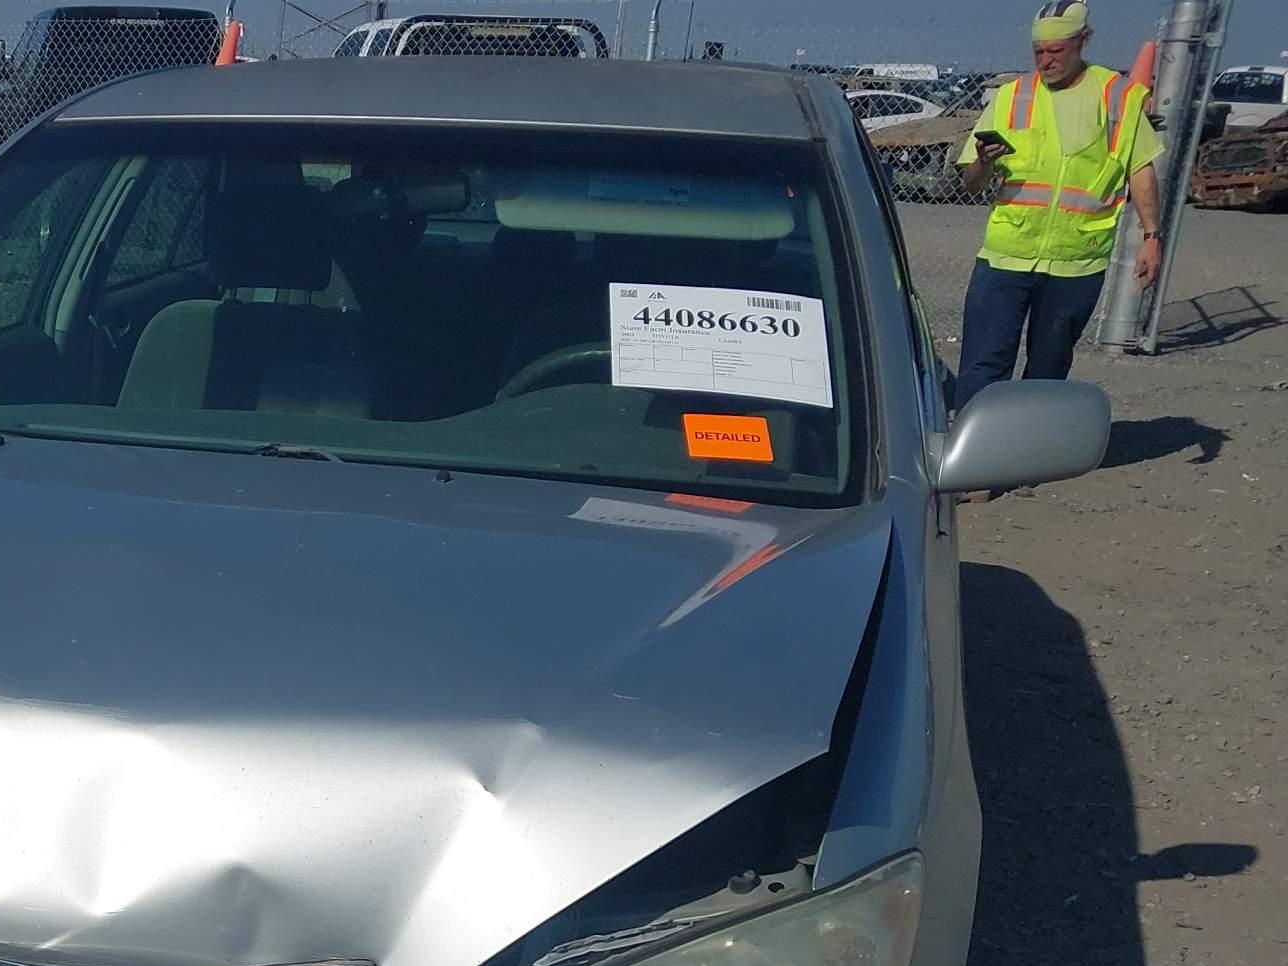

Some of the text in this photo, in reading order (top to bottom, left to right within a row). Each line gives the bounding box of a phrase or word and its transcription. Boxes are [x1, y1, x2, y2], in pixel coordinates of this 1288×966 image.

[632, 306, 801, 338] 44086630
[620, 324, 711, 336] State Farm Insurance
[694, 431, 761, 443] DETAILED
